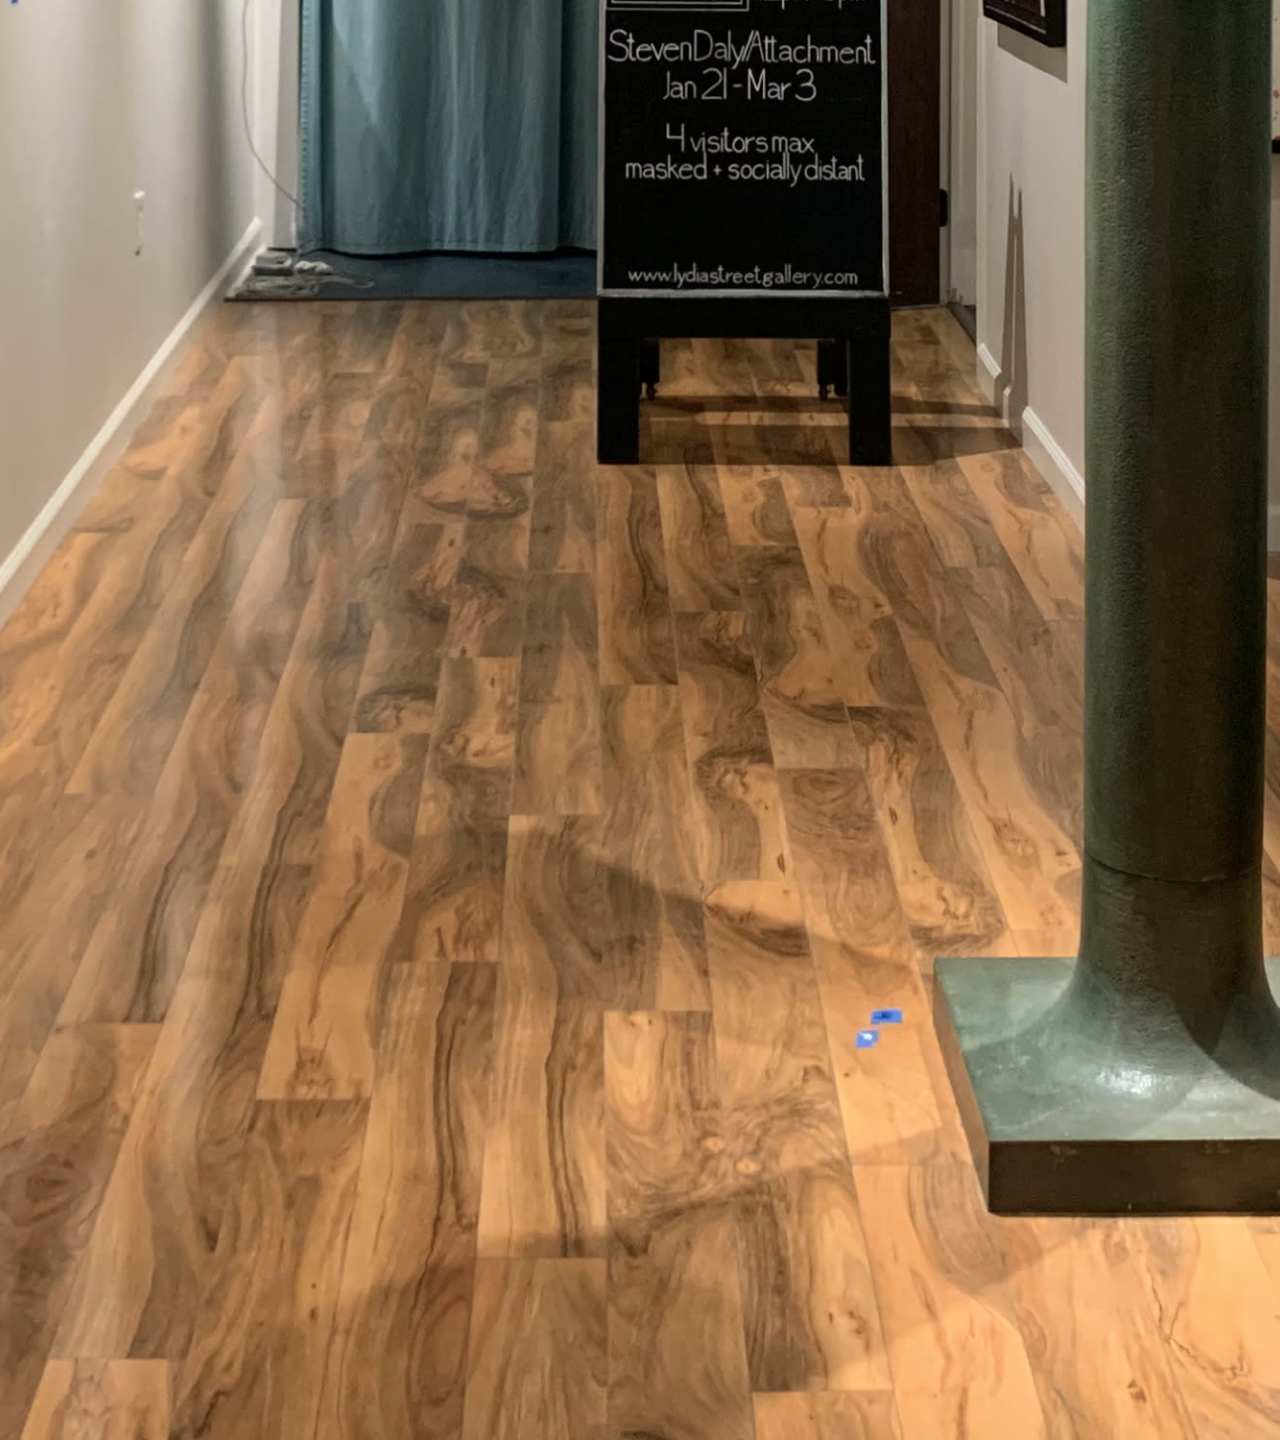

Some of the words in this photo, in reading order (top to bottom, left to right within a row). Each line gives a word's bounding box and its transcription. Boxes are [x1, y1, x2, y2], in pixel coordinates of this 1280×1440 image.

[662, 70, 697, 100] Jan
[701, 67, 727, 100] 21
[747, 68, 792, 101] Mar
[795, 68, 817, 101] 3
[666, 123, 685, 152] 4
[690, 127, 769, 153] visitors
[772, 136, 815, 153] max
[625, 154, 707, 180] masked
[727, 152, 803, 188] socially
[804, 153, 866, 181] distant
